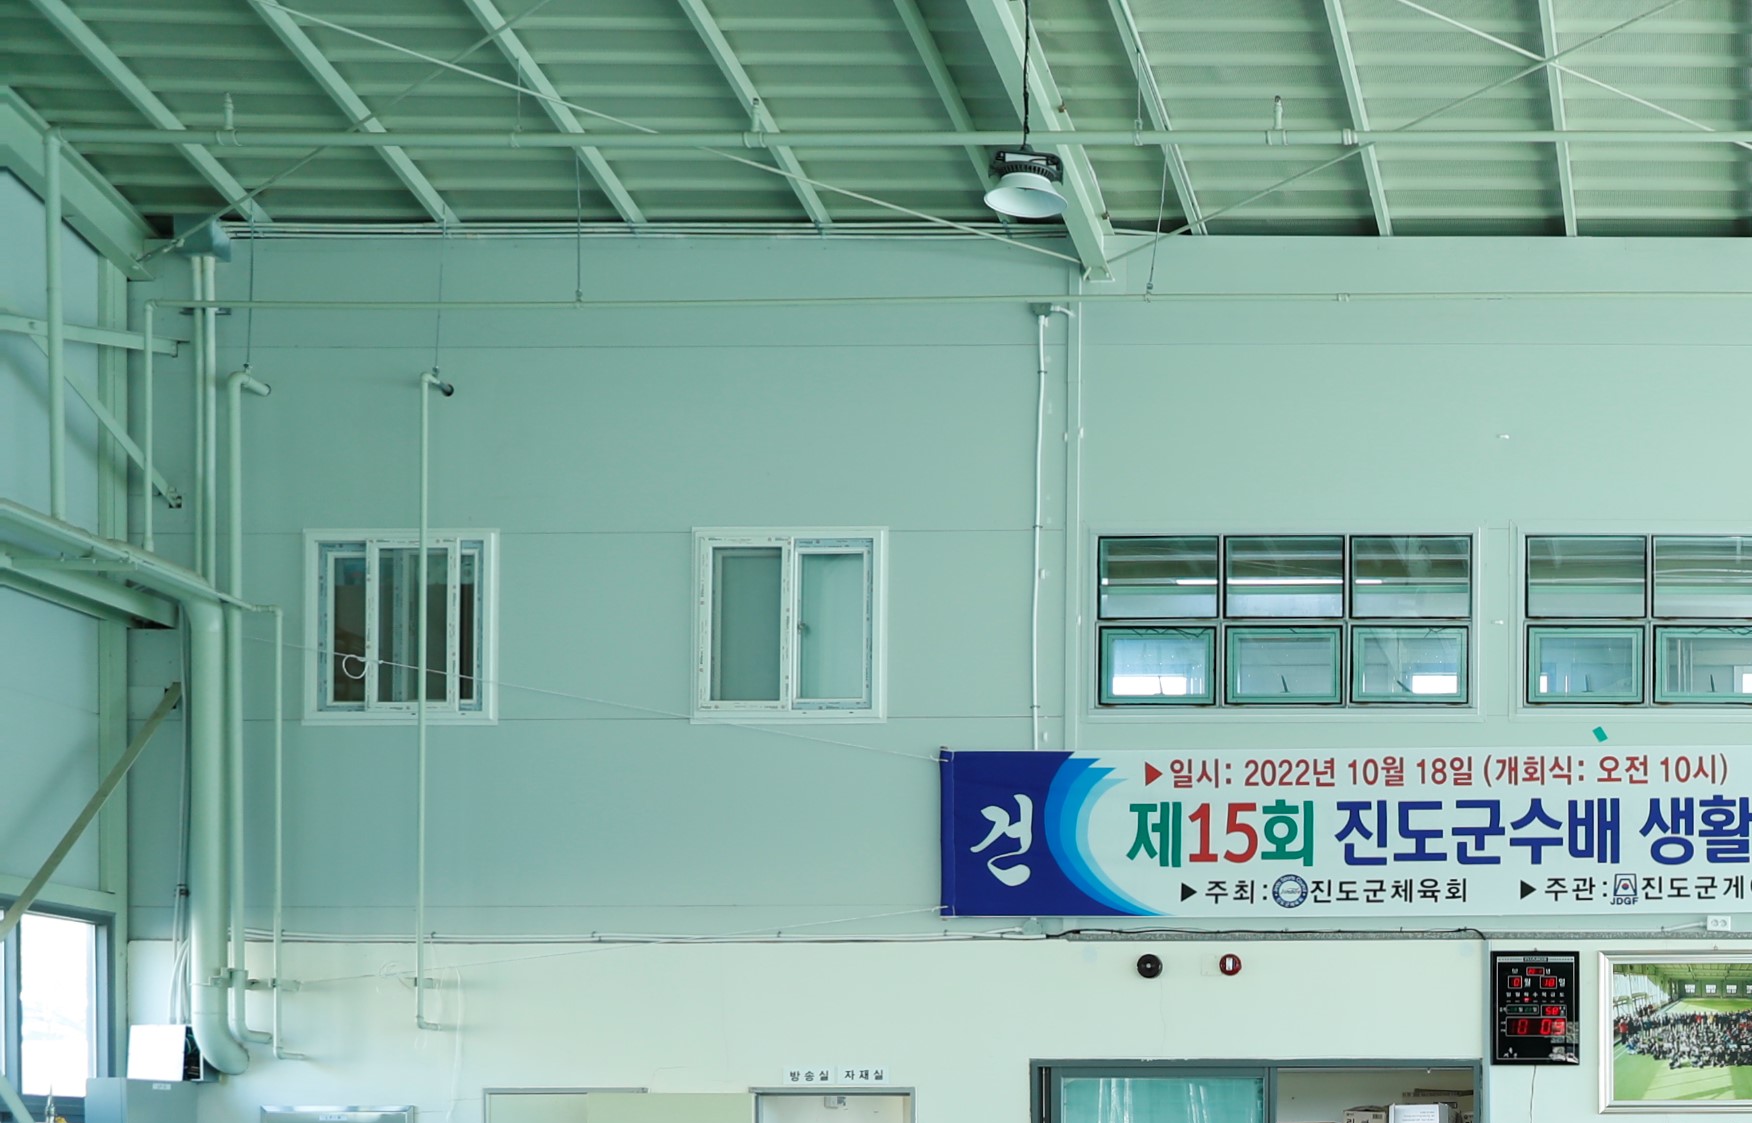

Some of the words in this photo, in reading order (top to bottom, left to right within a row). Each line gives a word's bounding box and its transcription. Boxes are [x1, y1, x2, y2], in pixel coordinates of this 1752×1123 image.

[1170, 756, 1231, 788] 일시:
[1245, 756, 1335, 787] 2022년
[1348, 756, 1404, 786] 10월
[1417, 755, 1472, 786] 18일
[1484, 754, 1584, 786] (개회식:
[1597, 754, 1648, 785] 오전
[1660, 754, 1727, 785] 10시)
[969, 793, 1034, 887] 건
[1126, 799, 1314, 868] 제15회
[1335, 798, 1620, 866] 진도군수배
[1205, 880, 1267, 904] 주최:
[1310, 878, 1466, 903] 진도군체육회
[1545, 877, 1607, 901] 주관:
[1610, 897, 1639, 905] JDGF
[789, 1070, 829, 1082] 방송실
[844, 1069, 884, 1081] 자재실
